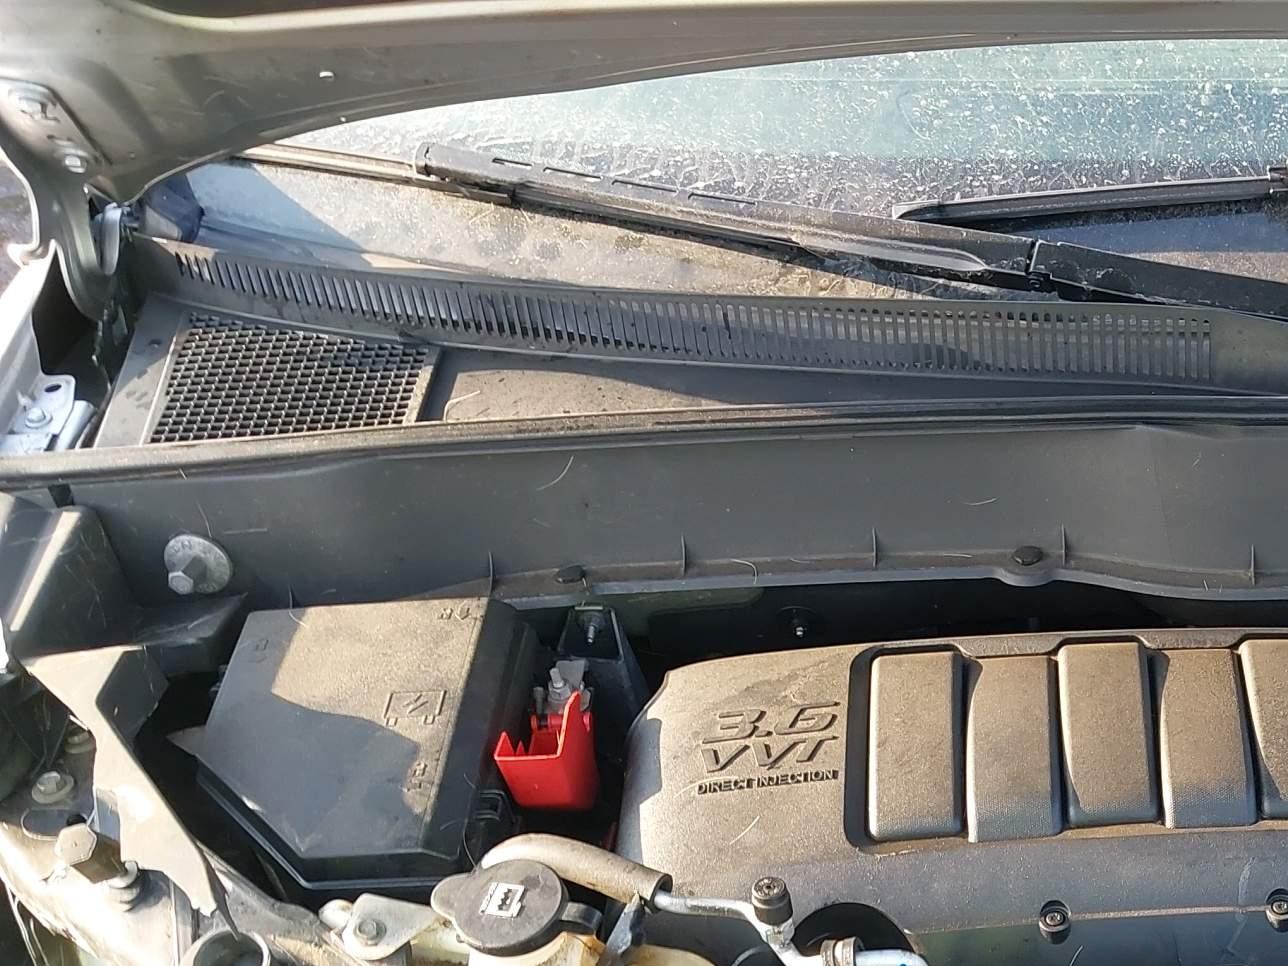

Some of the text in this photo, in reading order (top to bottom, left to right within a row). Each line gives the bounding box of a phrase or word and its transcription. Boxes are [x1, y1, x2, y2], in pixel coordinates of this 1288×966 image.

[702, 701, 840, 745] 3.6
[700, 736, 840, 773] VVT
[697, 769, 839, 795] DIRECT INJECTION
